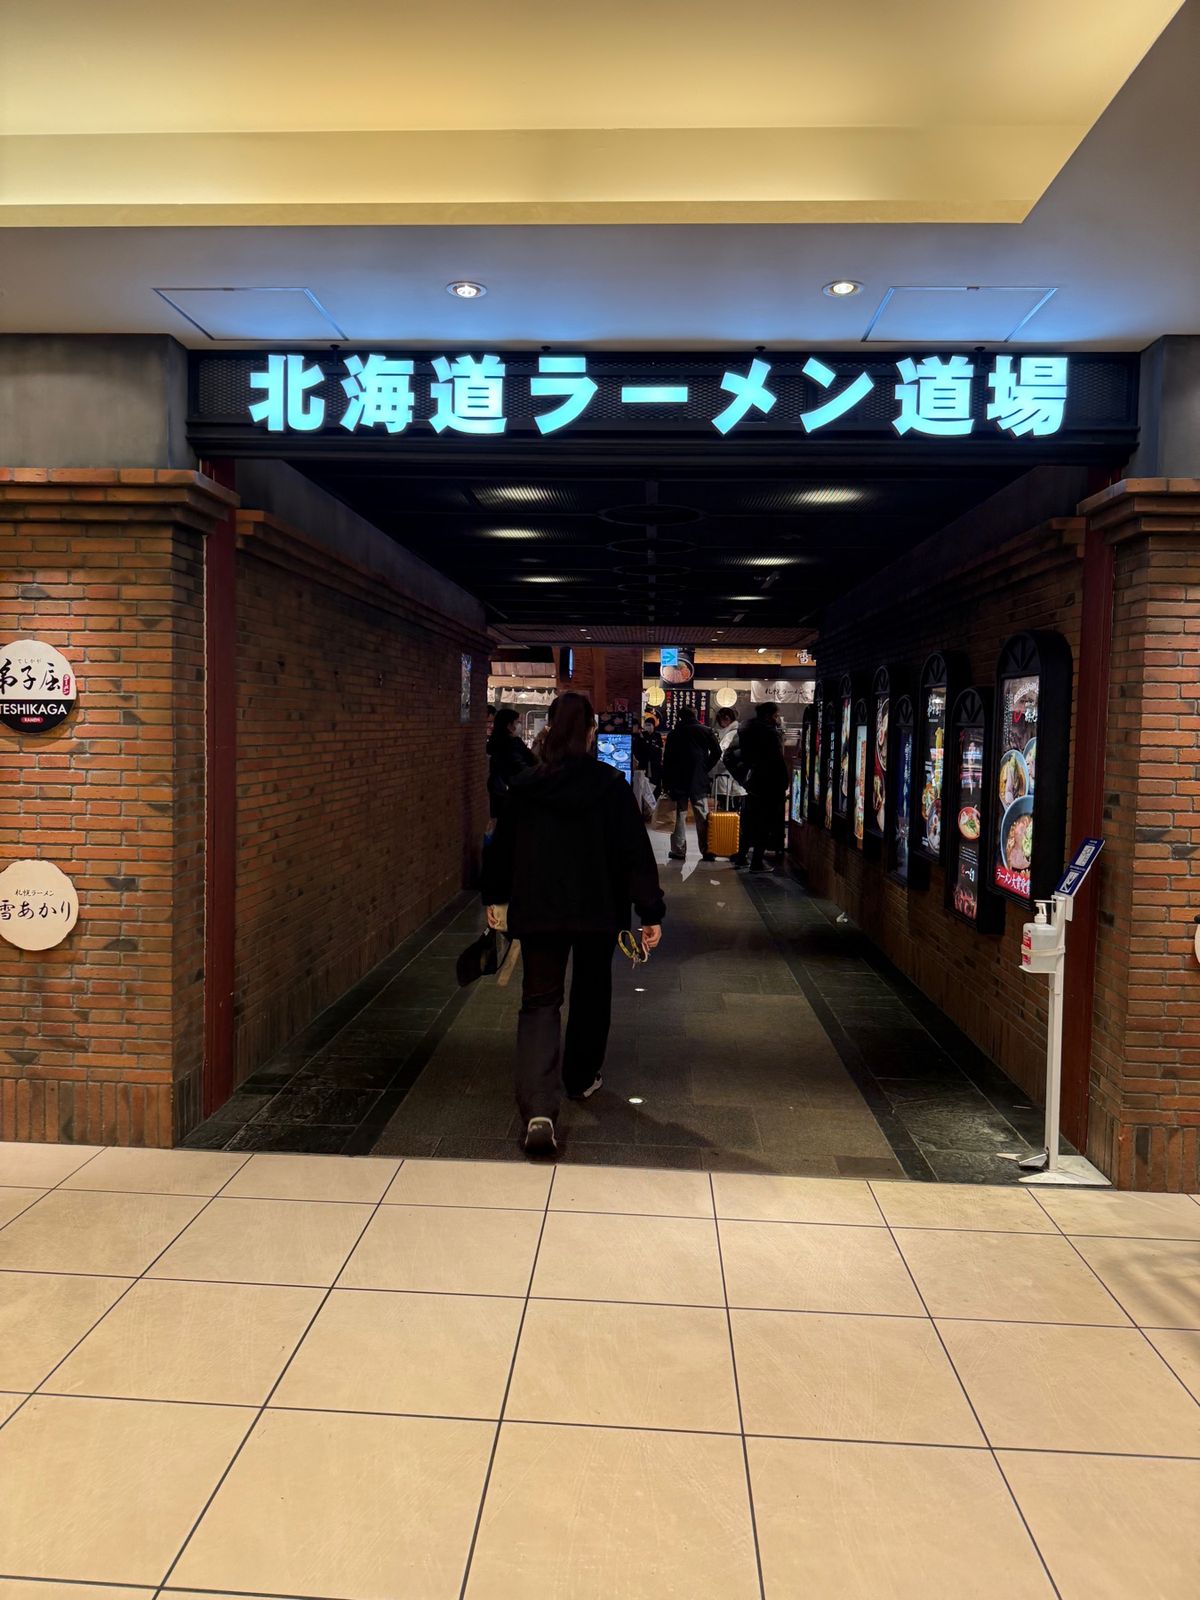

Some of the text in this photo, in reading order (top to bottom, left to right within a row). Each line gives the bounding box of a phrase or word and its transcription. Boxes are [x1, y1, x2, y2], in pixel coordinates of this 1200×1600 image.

[249, 354, 1069, 436] 北海道ラーメン道場
[0, 704, 67, 715] TESHIKAGA
[0, 899, 70, 922] 雪あかり
